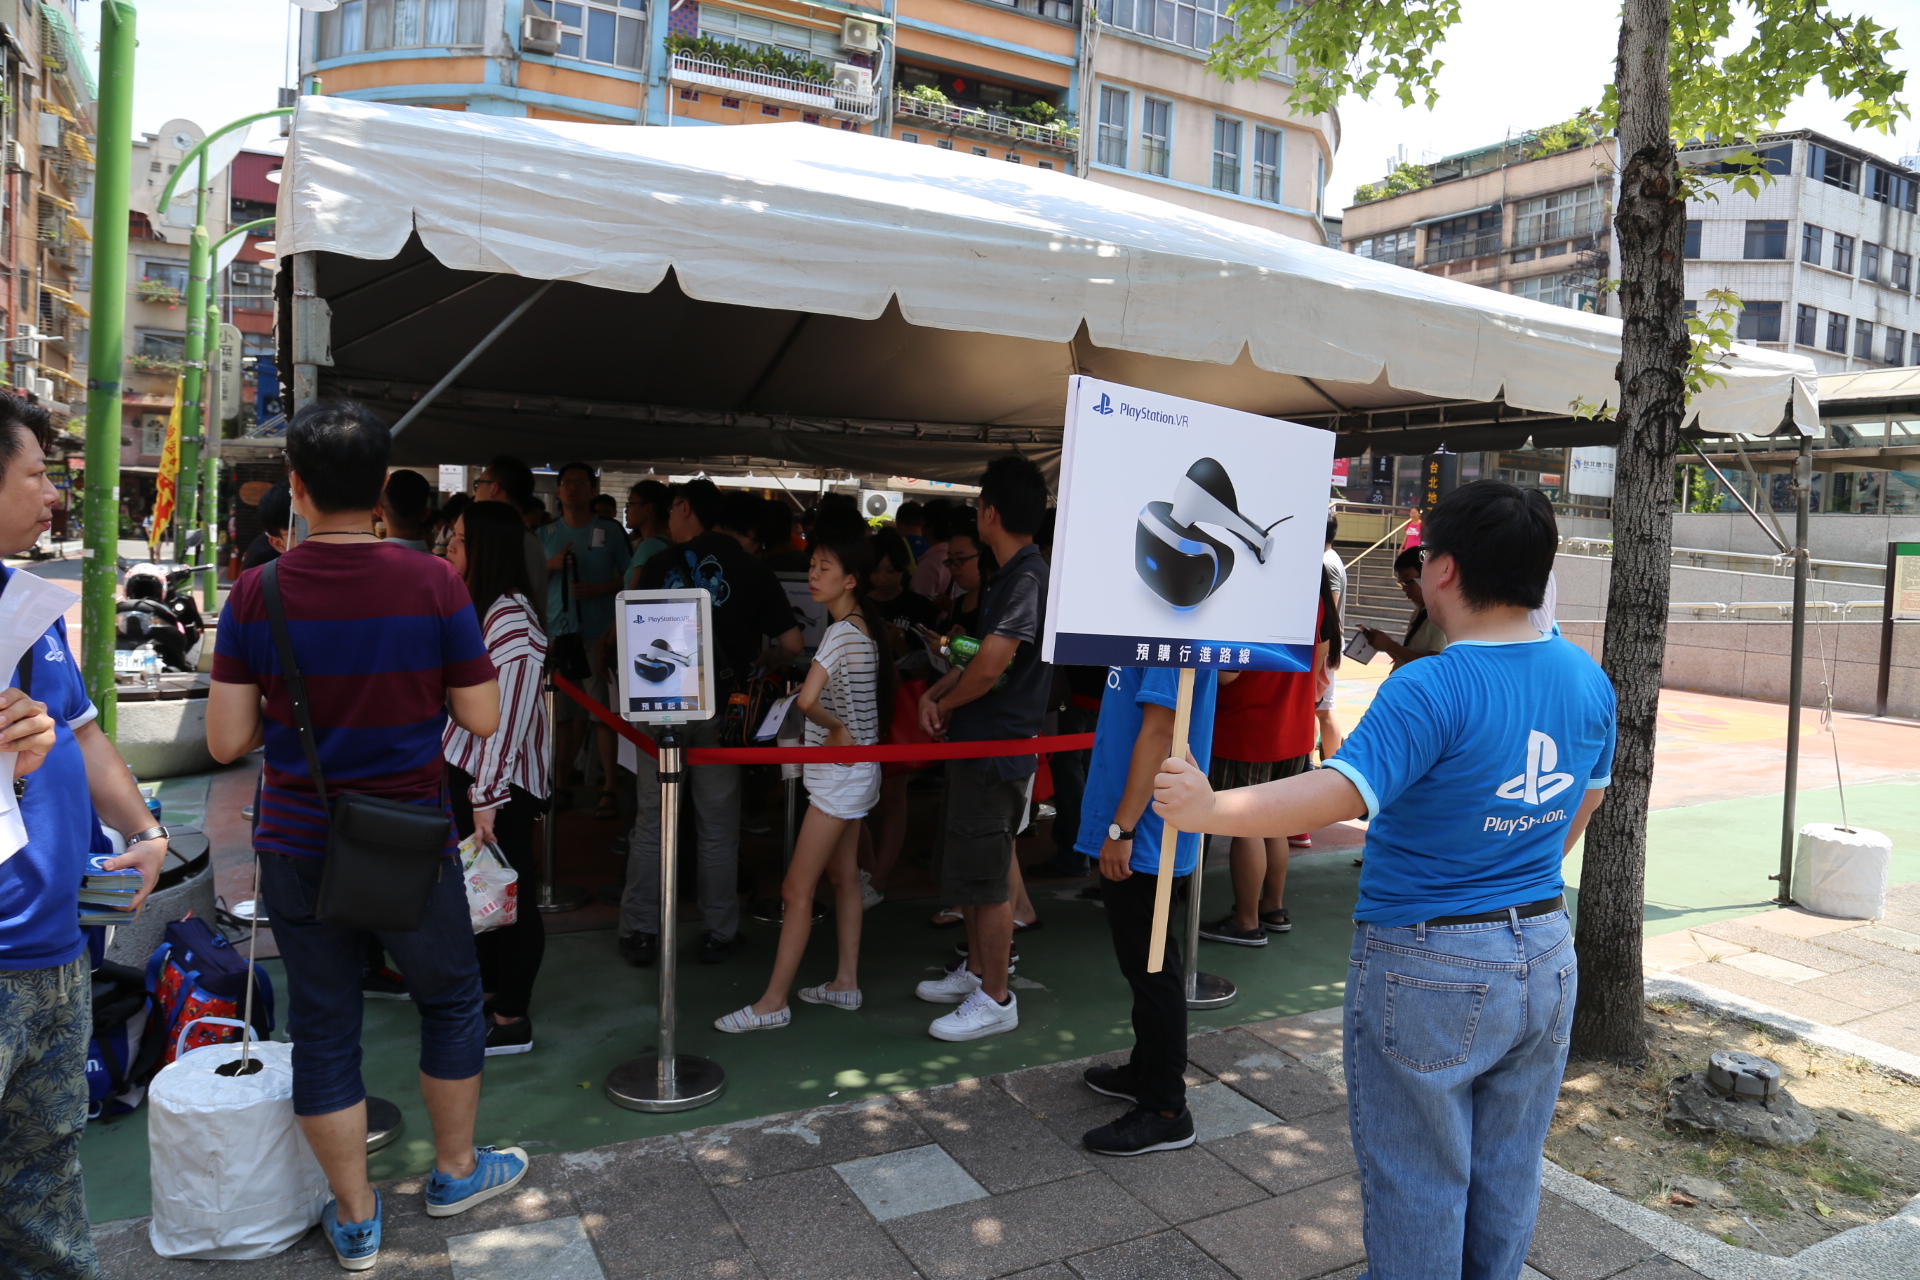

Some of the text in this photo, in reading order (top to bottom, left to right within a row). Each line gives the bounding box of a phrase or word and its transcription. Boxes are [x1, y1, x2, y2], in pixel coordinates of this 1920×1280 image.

[1427, 461, 1439, 511] 台北地
[1135, 642, 1251, 665] 預購行進路線
[641, 701, 690, 711] 預購起點
[1483, 808, 1565, 837] PlayStion
[347, 1243, 374, 1255] adidas
